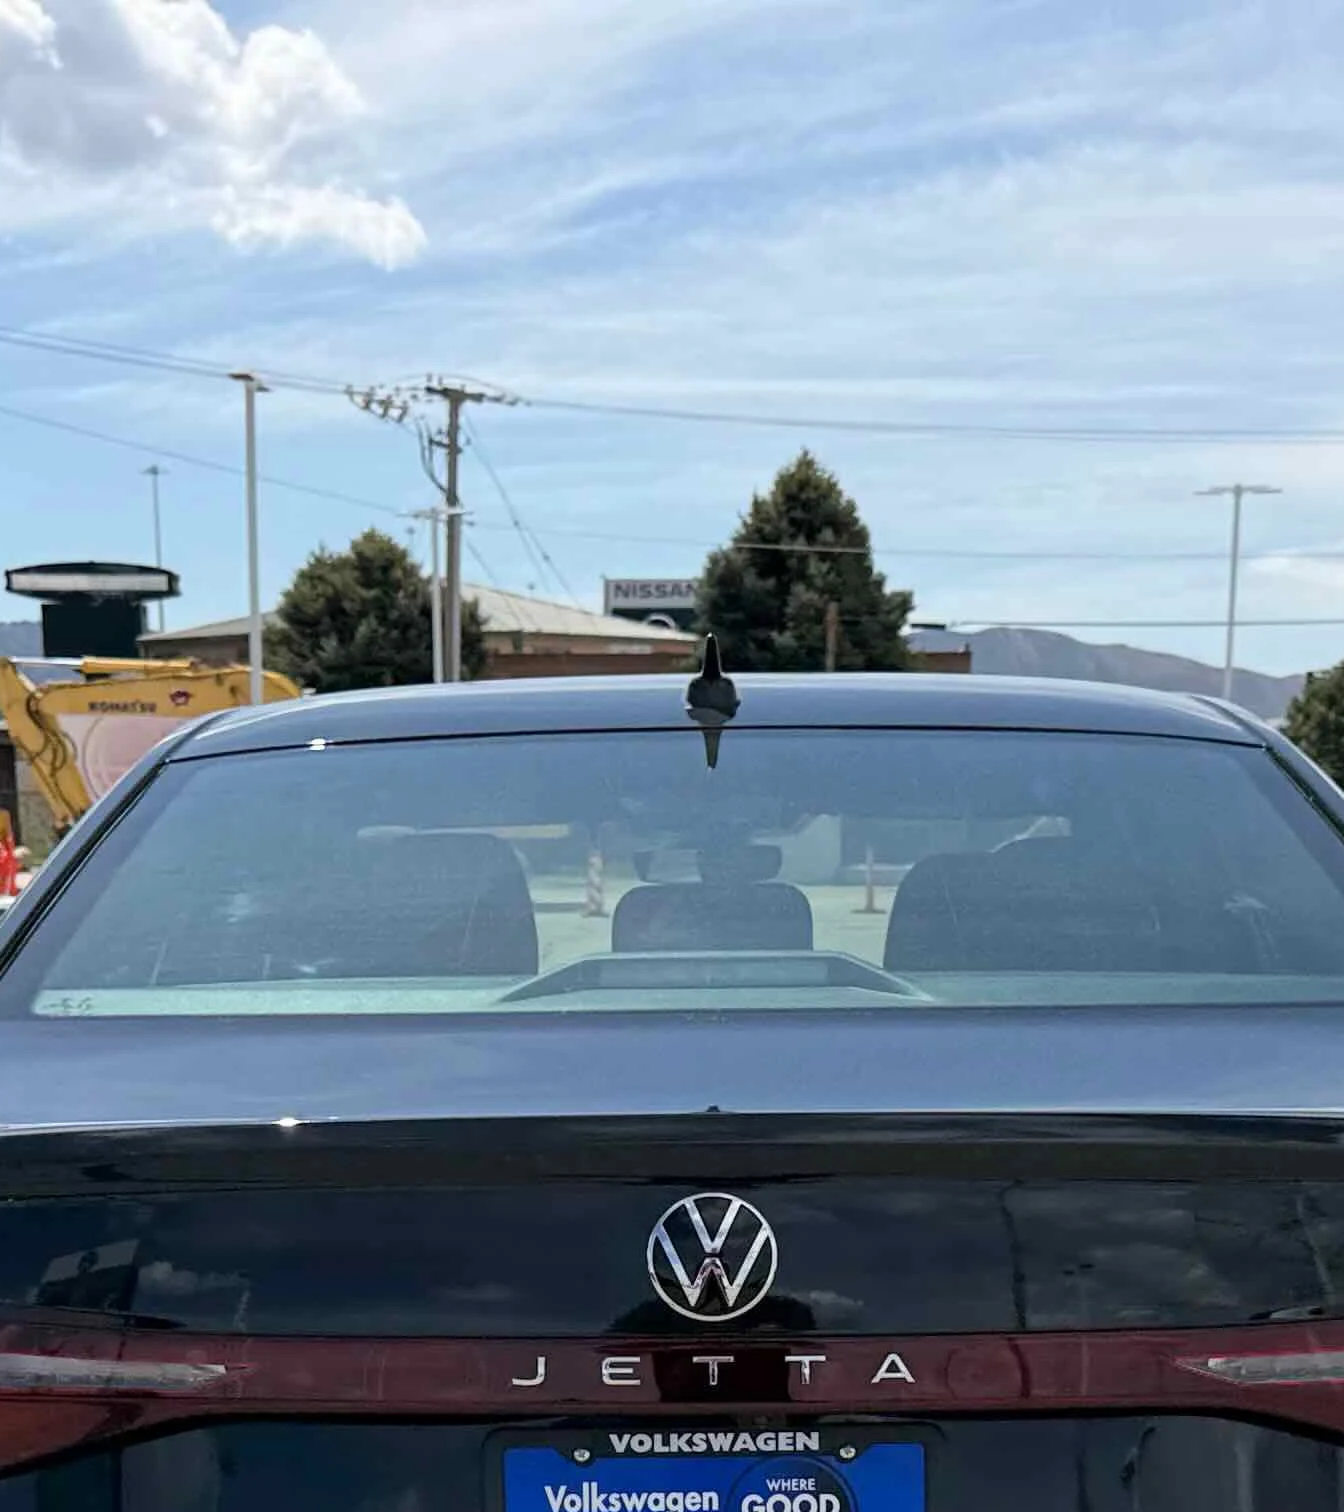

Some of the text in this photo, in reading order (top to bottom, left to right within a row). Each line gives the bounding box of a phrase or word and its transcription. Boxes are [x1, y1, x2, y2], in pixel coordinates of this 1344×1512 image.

[511, 1353, 916, 1386] JETTA
[609, 1432, 820, 1453] VOLKSWAGEN
[766, 1478, 816, 1491] WHERE
